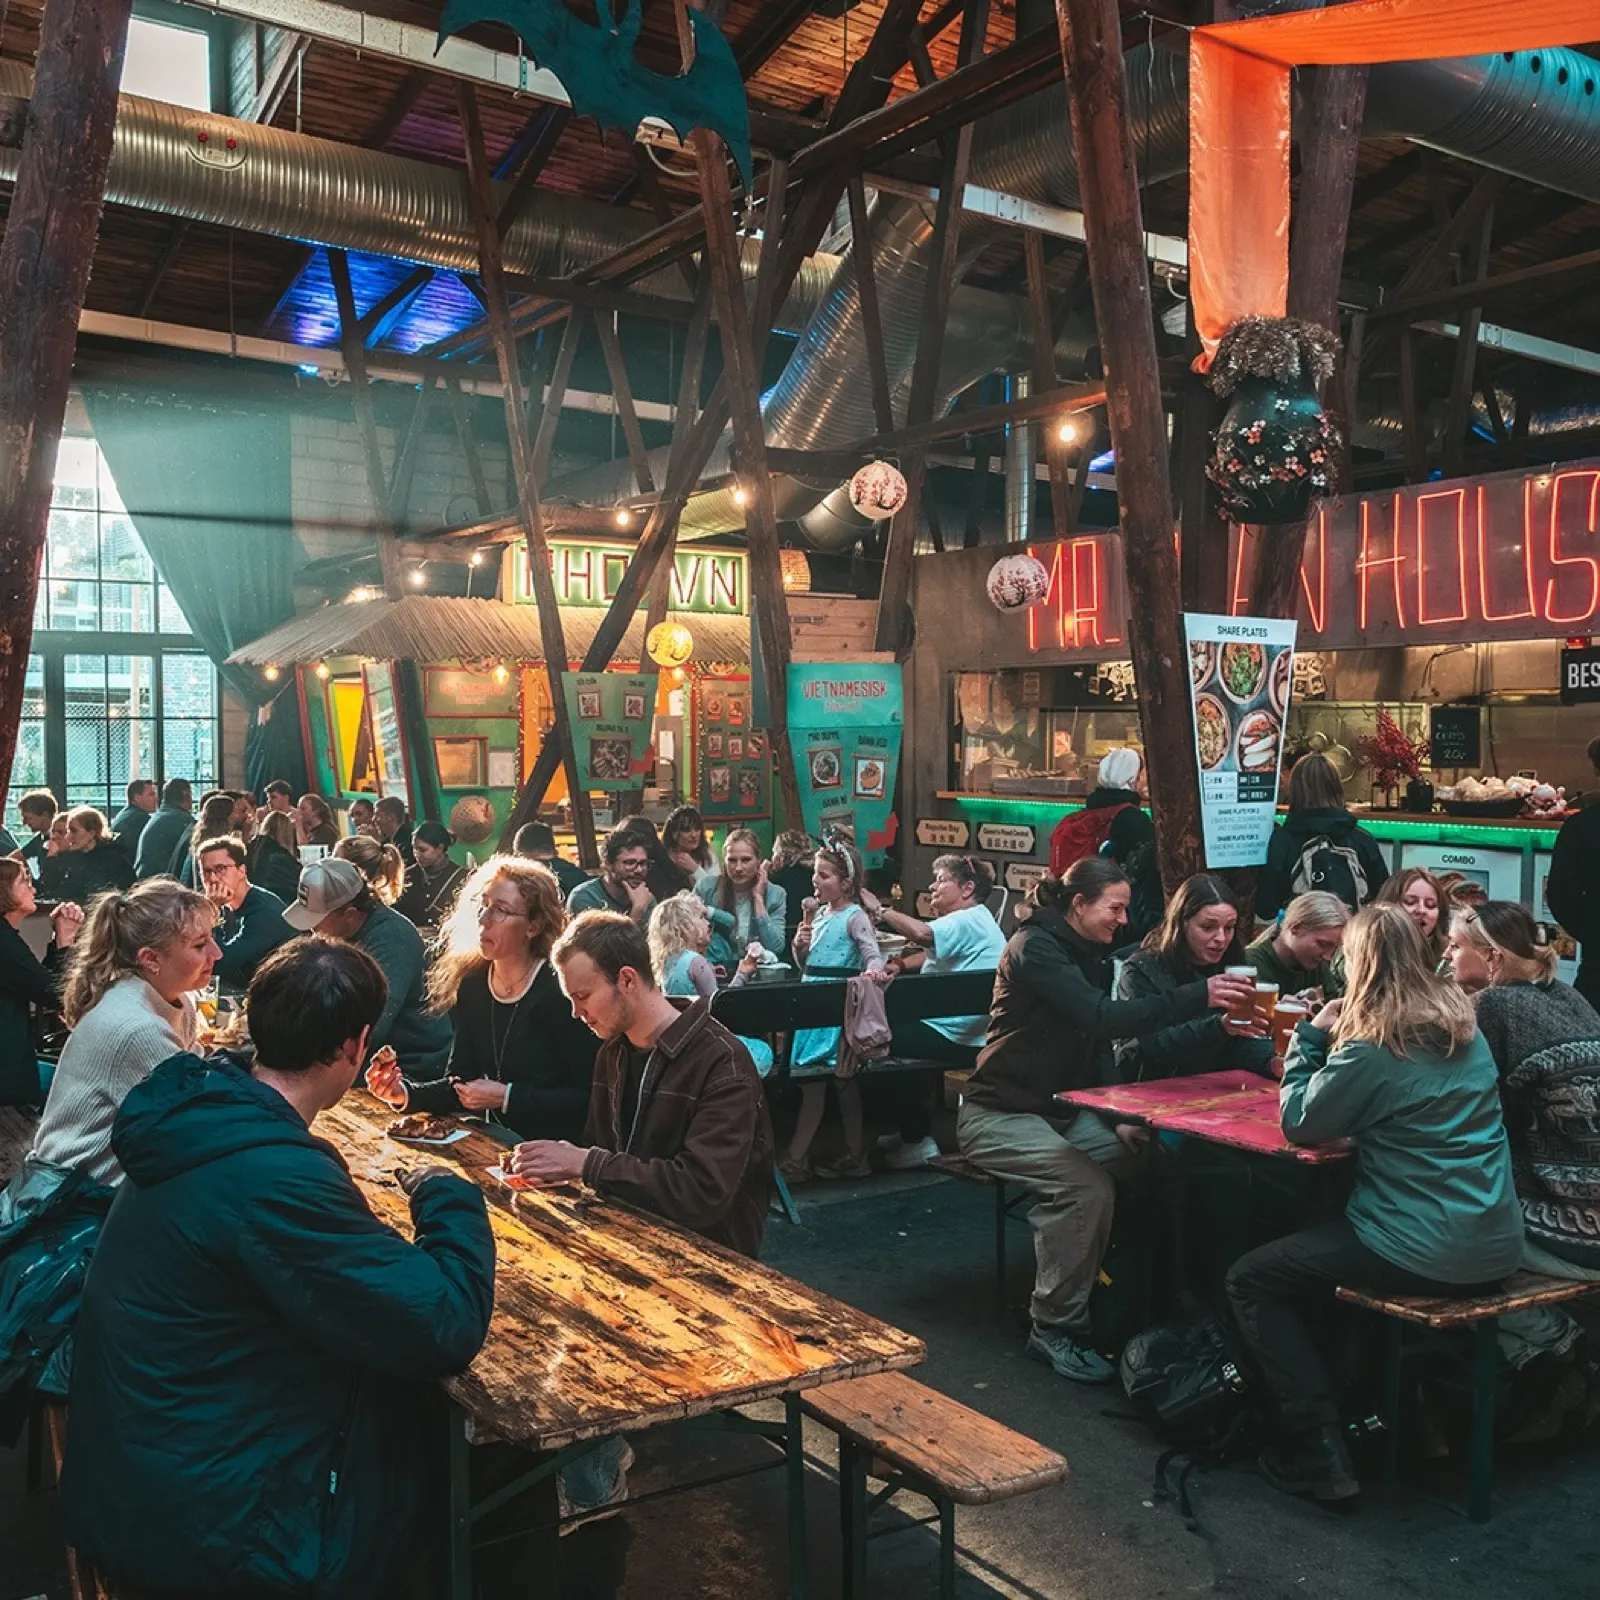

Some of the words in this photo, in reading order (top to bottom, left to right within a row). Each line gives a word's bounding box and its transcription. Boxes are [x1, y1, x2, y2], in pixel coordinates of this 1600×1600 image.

[1217, 625, 1241, 636] SHARE
[1241, 626, 1268, 638] PLATES
[803, 680, 888, 699] VIETNAMESISK
[948, 824, 960, 833] Bay
[1441, 854, 1476, 865] COMBO
